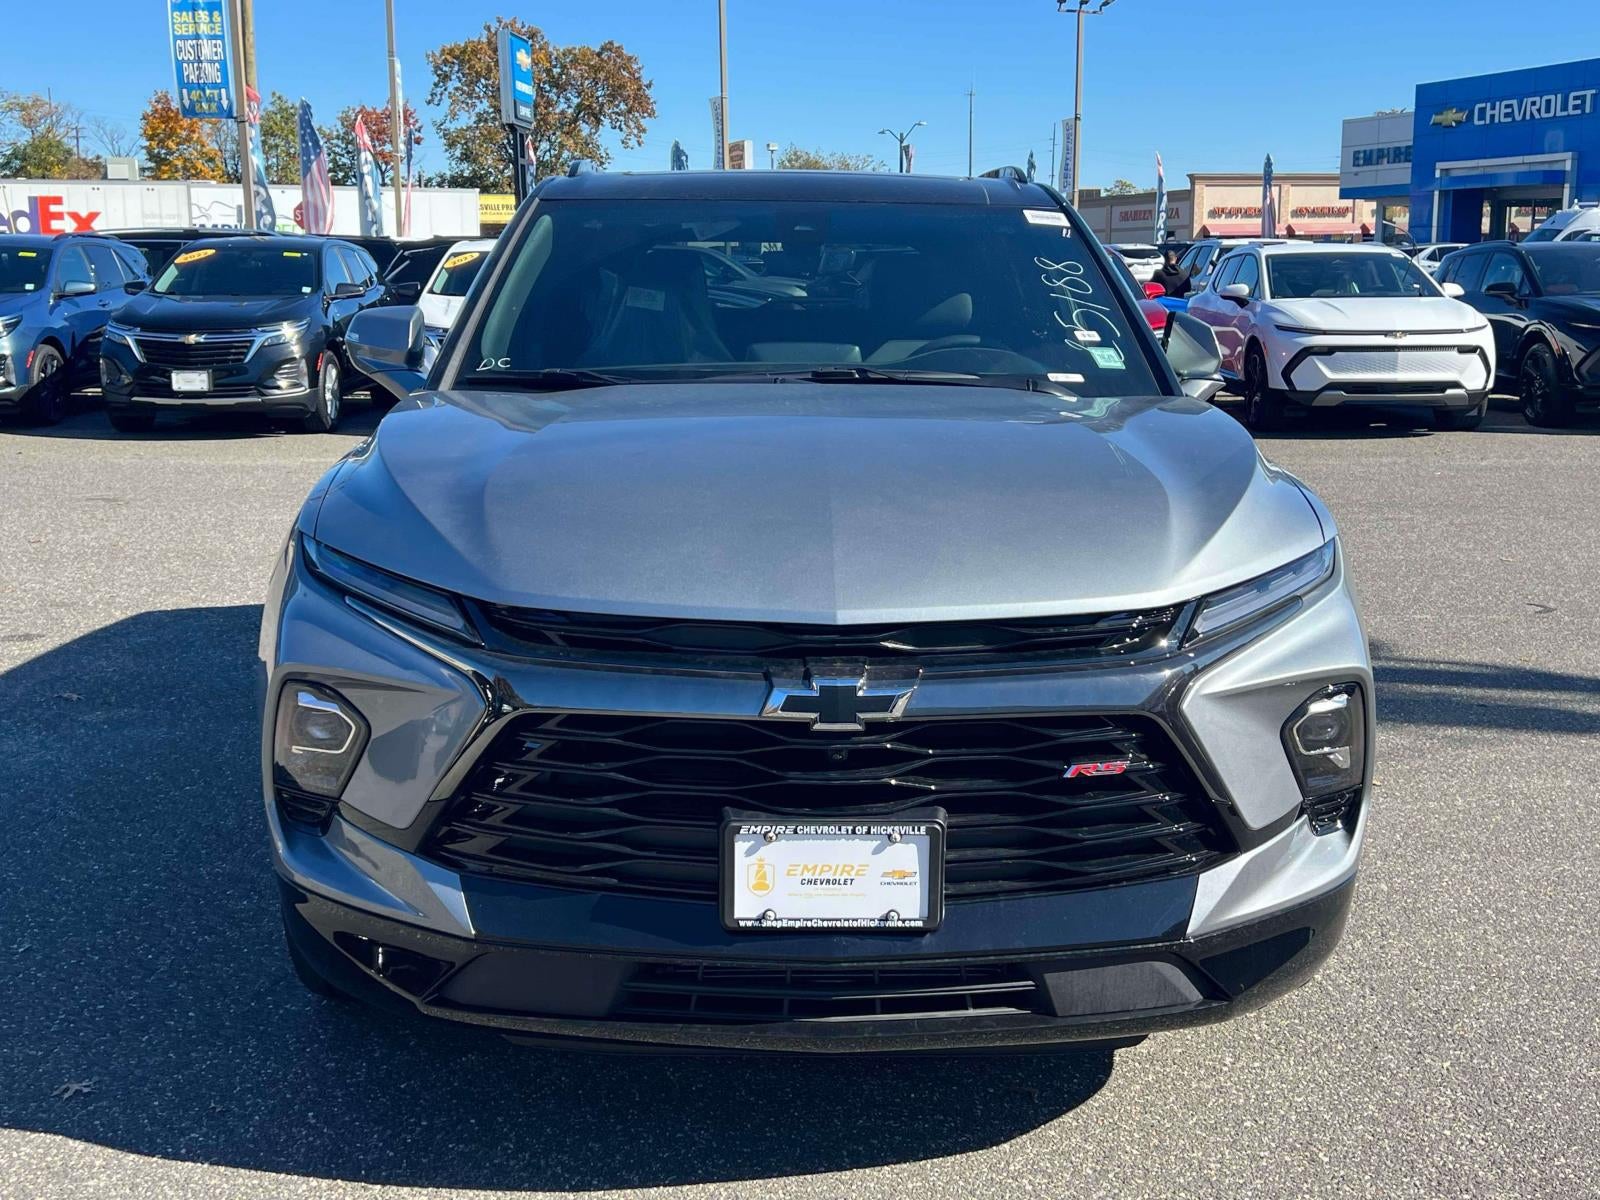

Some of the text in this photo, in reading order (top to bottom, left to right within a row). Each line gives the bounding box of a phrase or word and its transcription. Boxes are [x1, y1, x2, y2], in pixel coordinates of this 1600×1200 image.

[173, 11, 220, 22] SALES &
[174, 23, 222, 34] SERVICE
[176, 39, 224, 60] CUSTOMER
[183, 62, 221, 83] PARKING
[1473, 89, 1597, 126] CHEVROLET
[1352, 145, 1412, 168] EMPIRE
[1063, 761, 1128, 778] RS
[740, 825, 927, 835] EMPIRE CHEVROLET OF HICKSVILLE
[785, 864, 870, 877] EMPIRE
[800, 878, 855, 886] CHEVROLET
